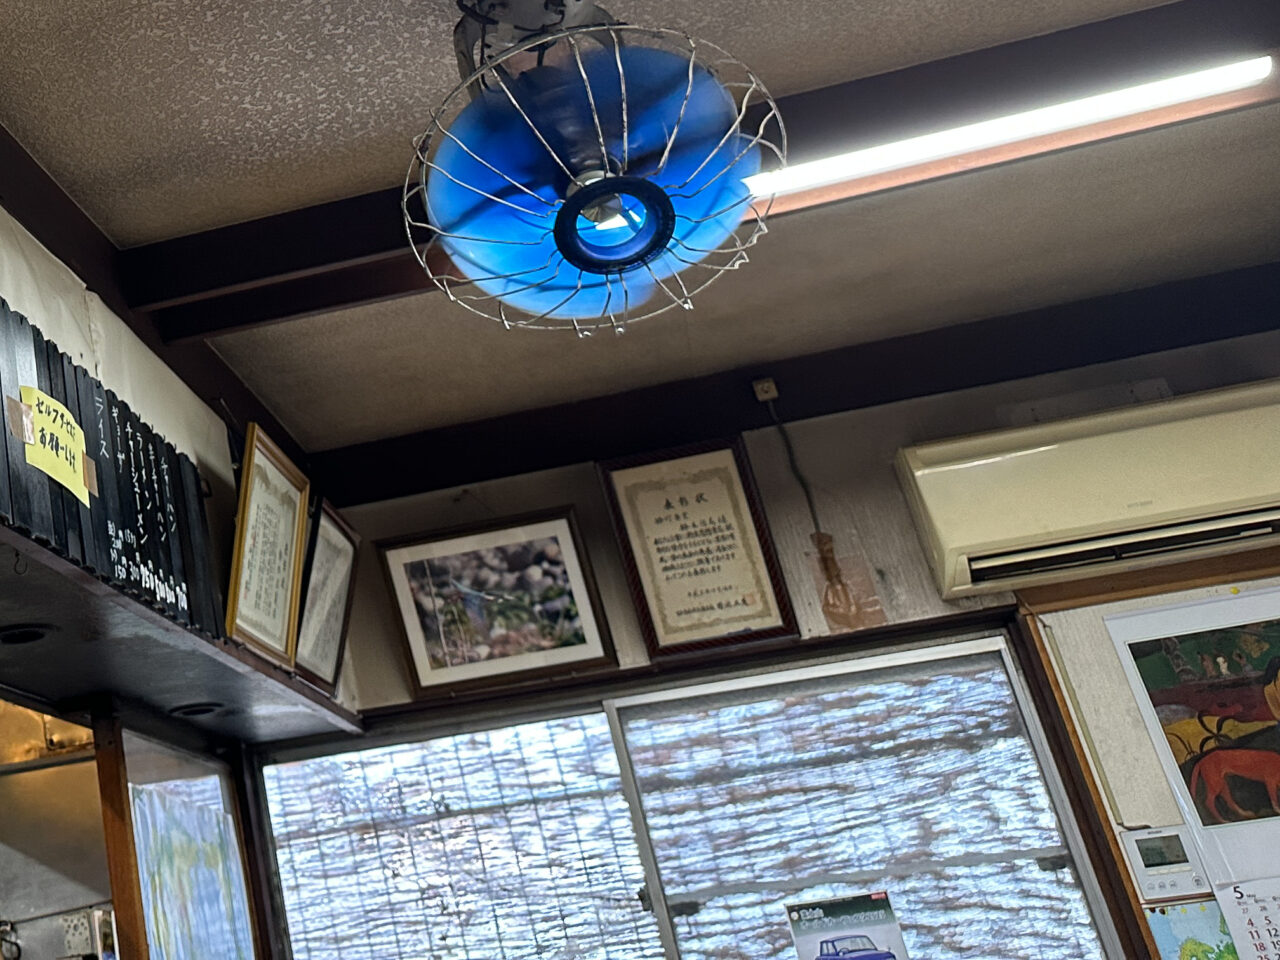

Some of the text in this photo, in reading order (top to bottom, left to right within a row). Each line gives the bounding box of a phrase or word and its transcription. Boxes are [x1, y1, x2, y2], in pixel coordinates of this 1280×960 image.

[95, 397, 110, 459] ライス
[136, 433, 152, 510] ラーメン
[1233, 885, 1244, 900] 5
[1247, 916, 1271, 927] 4 5
[1248, 928, 1279, 940] 11 12
[1253, 942, 1266, 952] 18
